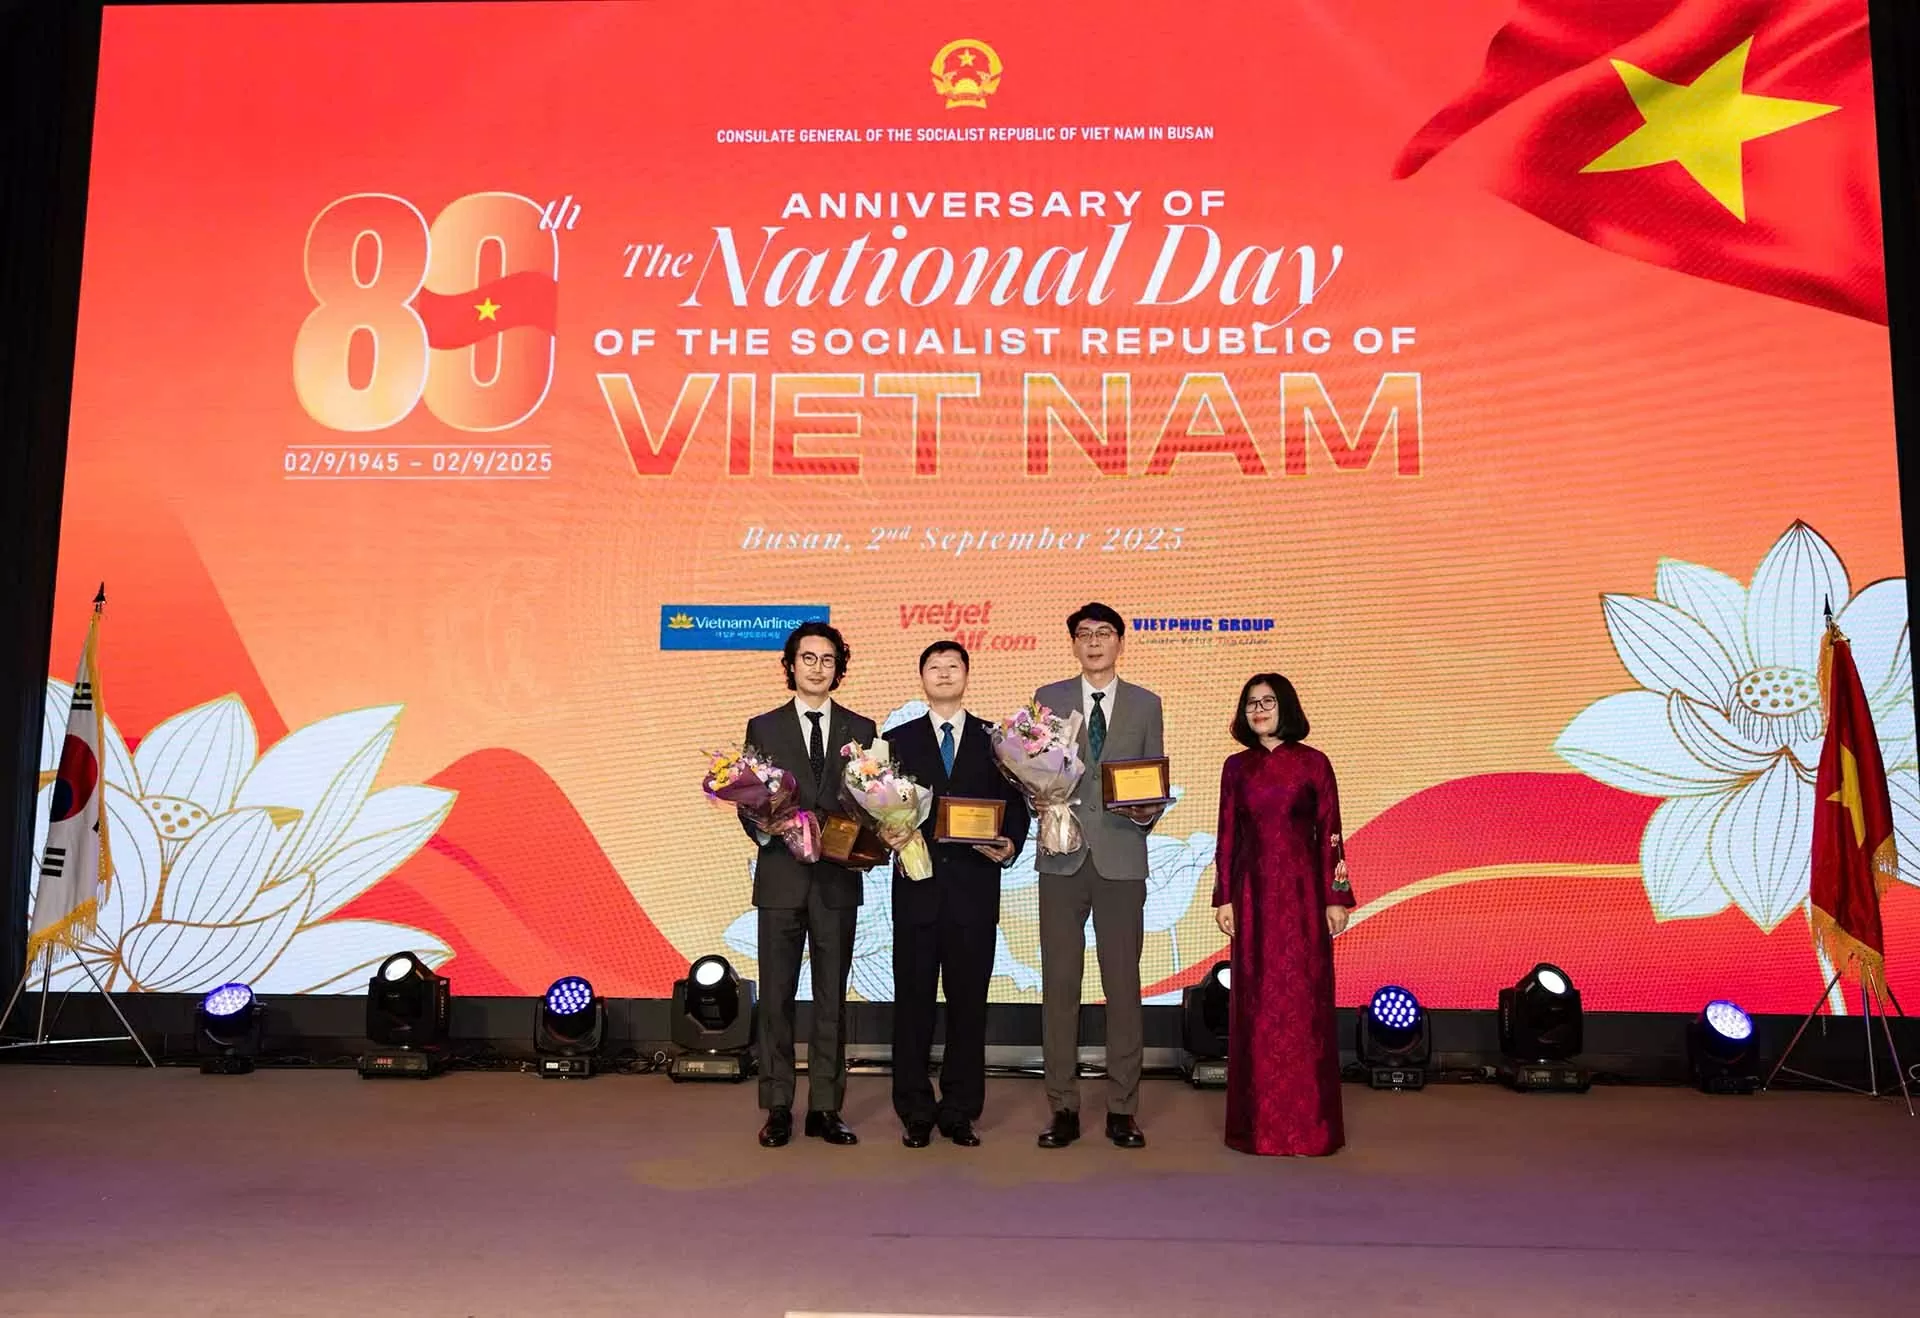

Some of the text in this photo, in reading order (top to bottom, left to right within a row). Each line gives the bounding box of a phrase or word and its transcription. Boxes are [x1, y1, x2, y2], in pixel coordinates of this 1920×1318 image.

[716, 126, 1214, 143] CONSULATE GENERAL OF THE SOCIALIST REPUBLIC OF VIET NAM IN BUSAN
[781, 190, 1225, 219] ANNIVERSARY OF
[623, 221, 1344, 333] The National Day
[593, 326, 1417, 356] OF THE SOCIALIST REPUBLIC OF
[595, 372, 1424, 479] VIET NAM
[284, 452, 400, 475] 02/9/1945
[432, 452, 553, 474] 02/9/2025
[864, 525, 912, 550] 2nd
[919, 525, 1091, 559] September
[1101, 526, 1185, 550] 2025
[695, 616, 750, 629] Vietnam
[753, 616, 802, 629] Airlines
[1132, 618, 1275, 631] VIETPHUC GROUP
